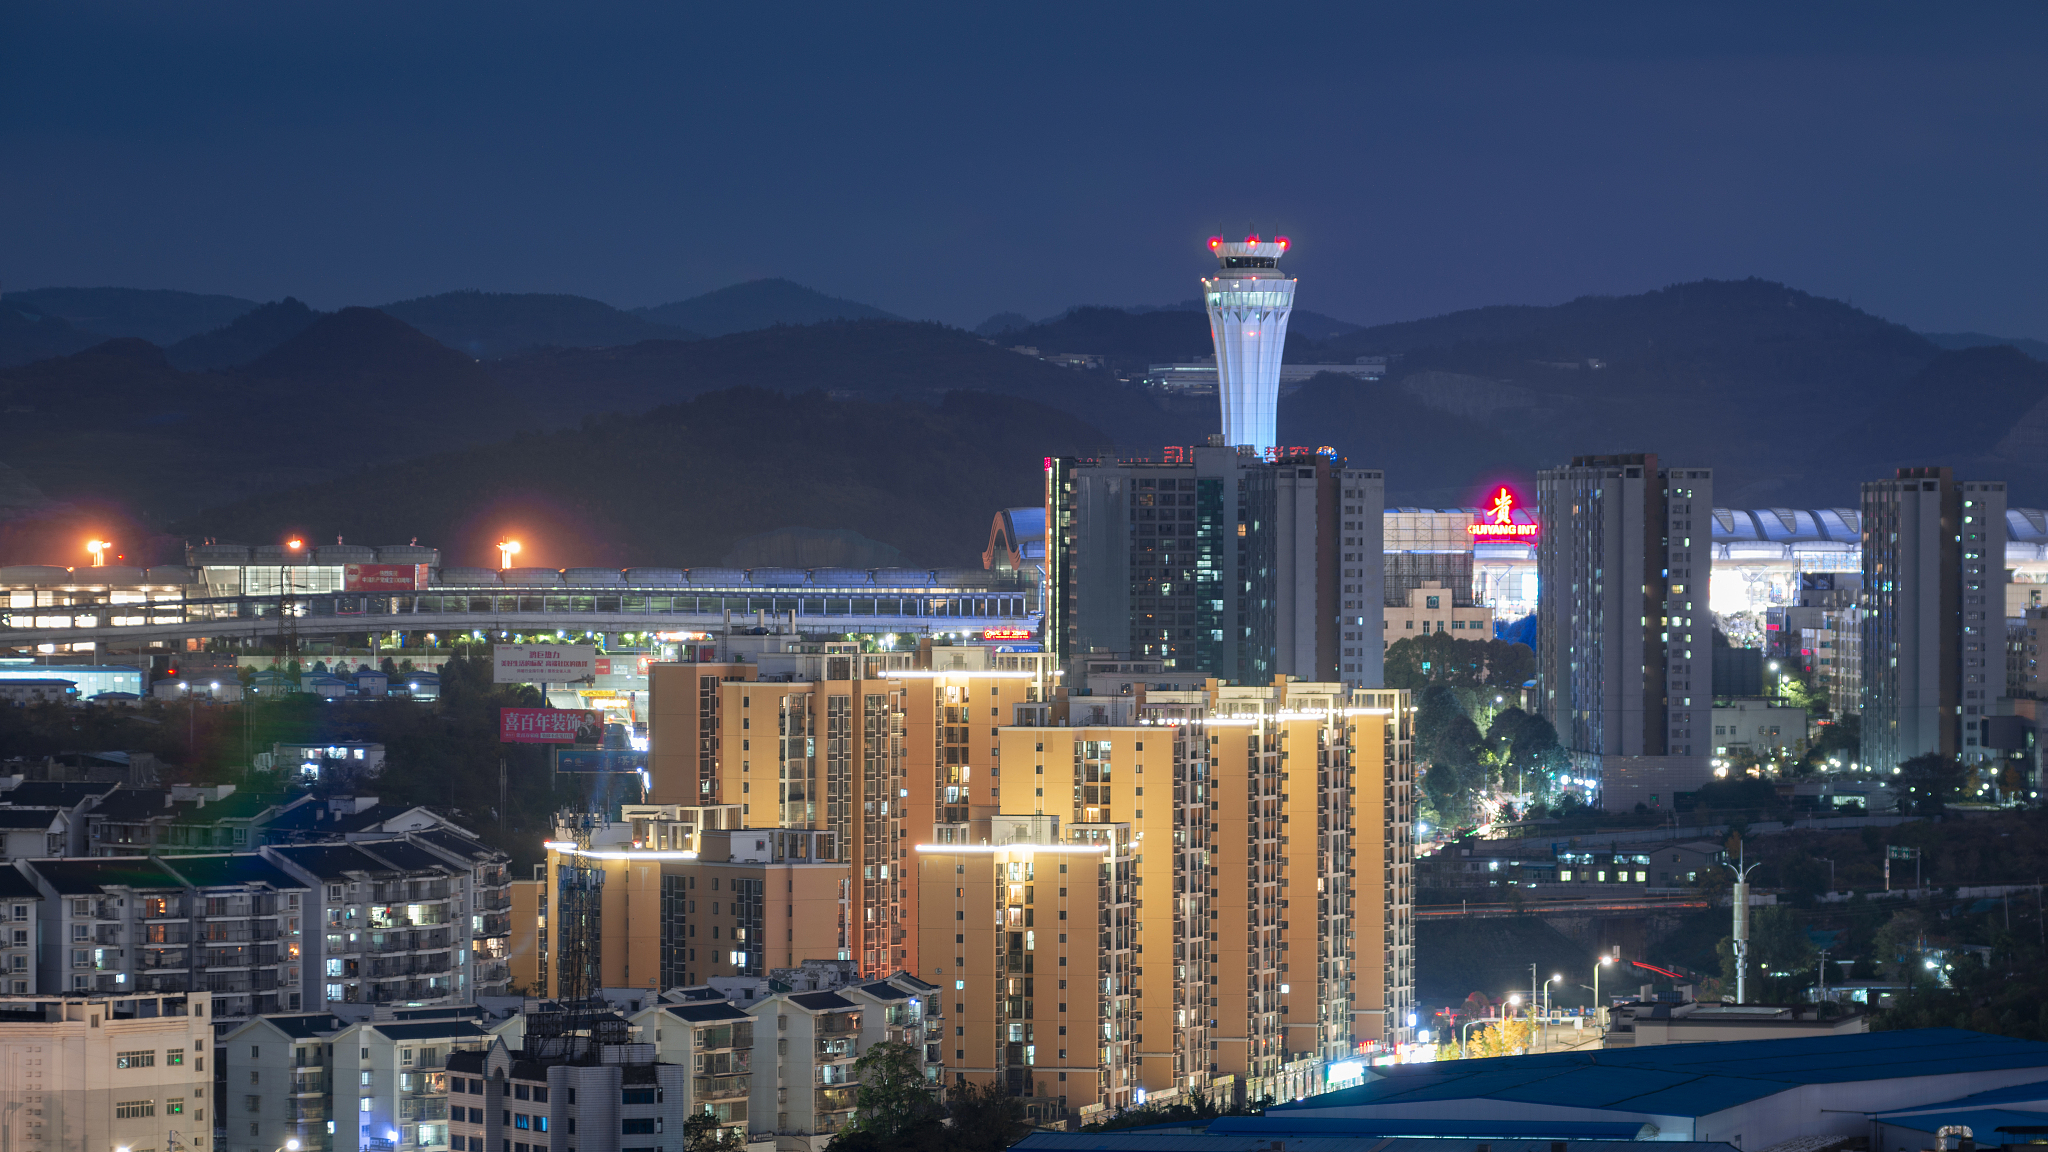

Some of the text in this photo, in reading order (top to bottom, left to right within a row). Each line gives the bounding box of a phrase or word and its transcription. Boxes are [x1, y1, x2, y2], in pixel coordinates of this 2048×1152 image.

[1487, 488, 1513, 525] 贵
[1518, 525, 1538, 535] INT
[504, 712, 582, 732] 喜百年装饰
